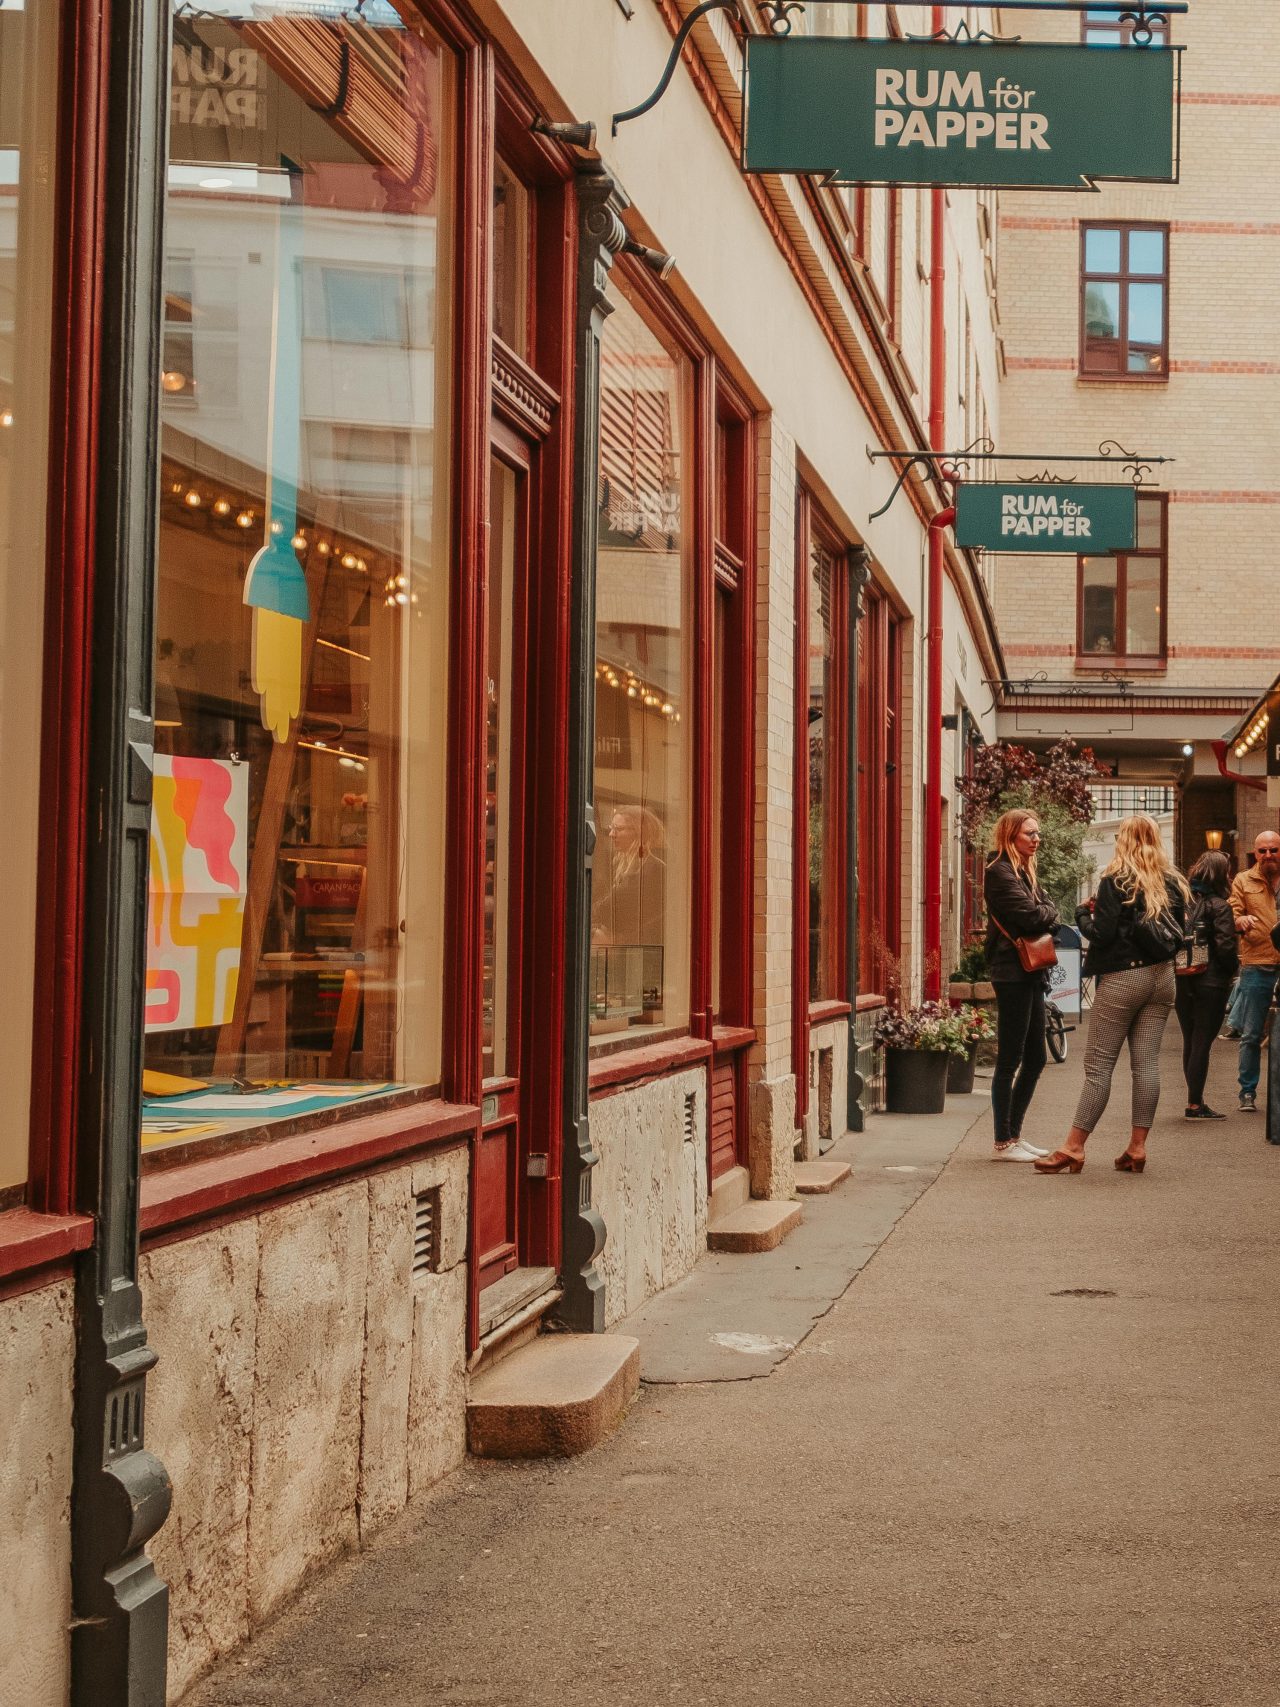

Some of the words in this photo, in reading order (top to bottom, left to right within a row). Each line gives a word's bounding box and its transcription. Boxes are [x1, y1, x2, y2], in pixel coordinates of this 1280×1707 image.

[875, 68, 985, 108] RUM
[988, 77, 1037, 109] för
[874, 109, 1052, 150] PAPPER
[1002, 494, 1058, 515] RUM
[1059, 498, 1084, 515] för
[1001, 515, 1092, 537] PAPPER
[313, 882, 342, 894] CARAN
